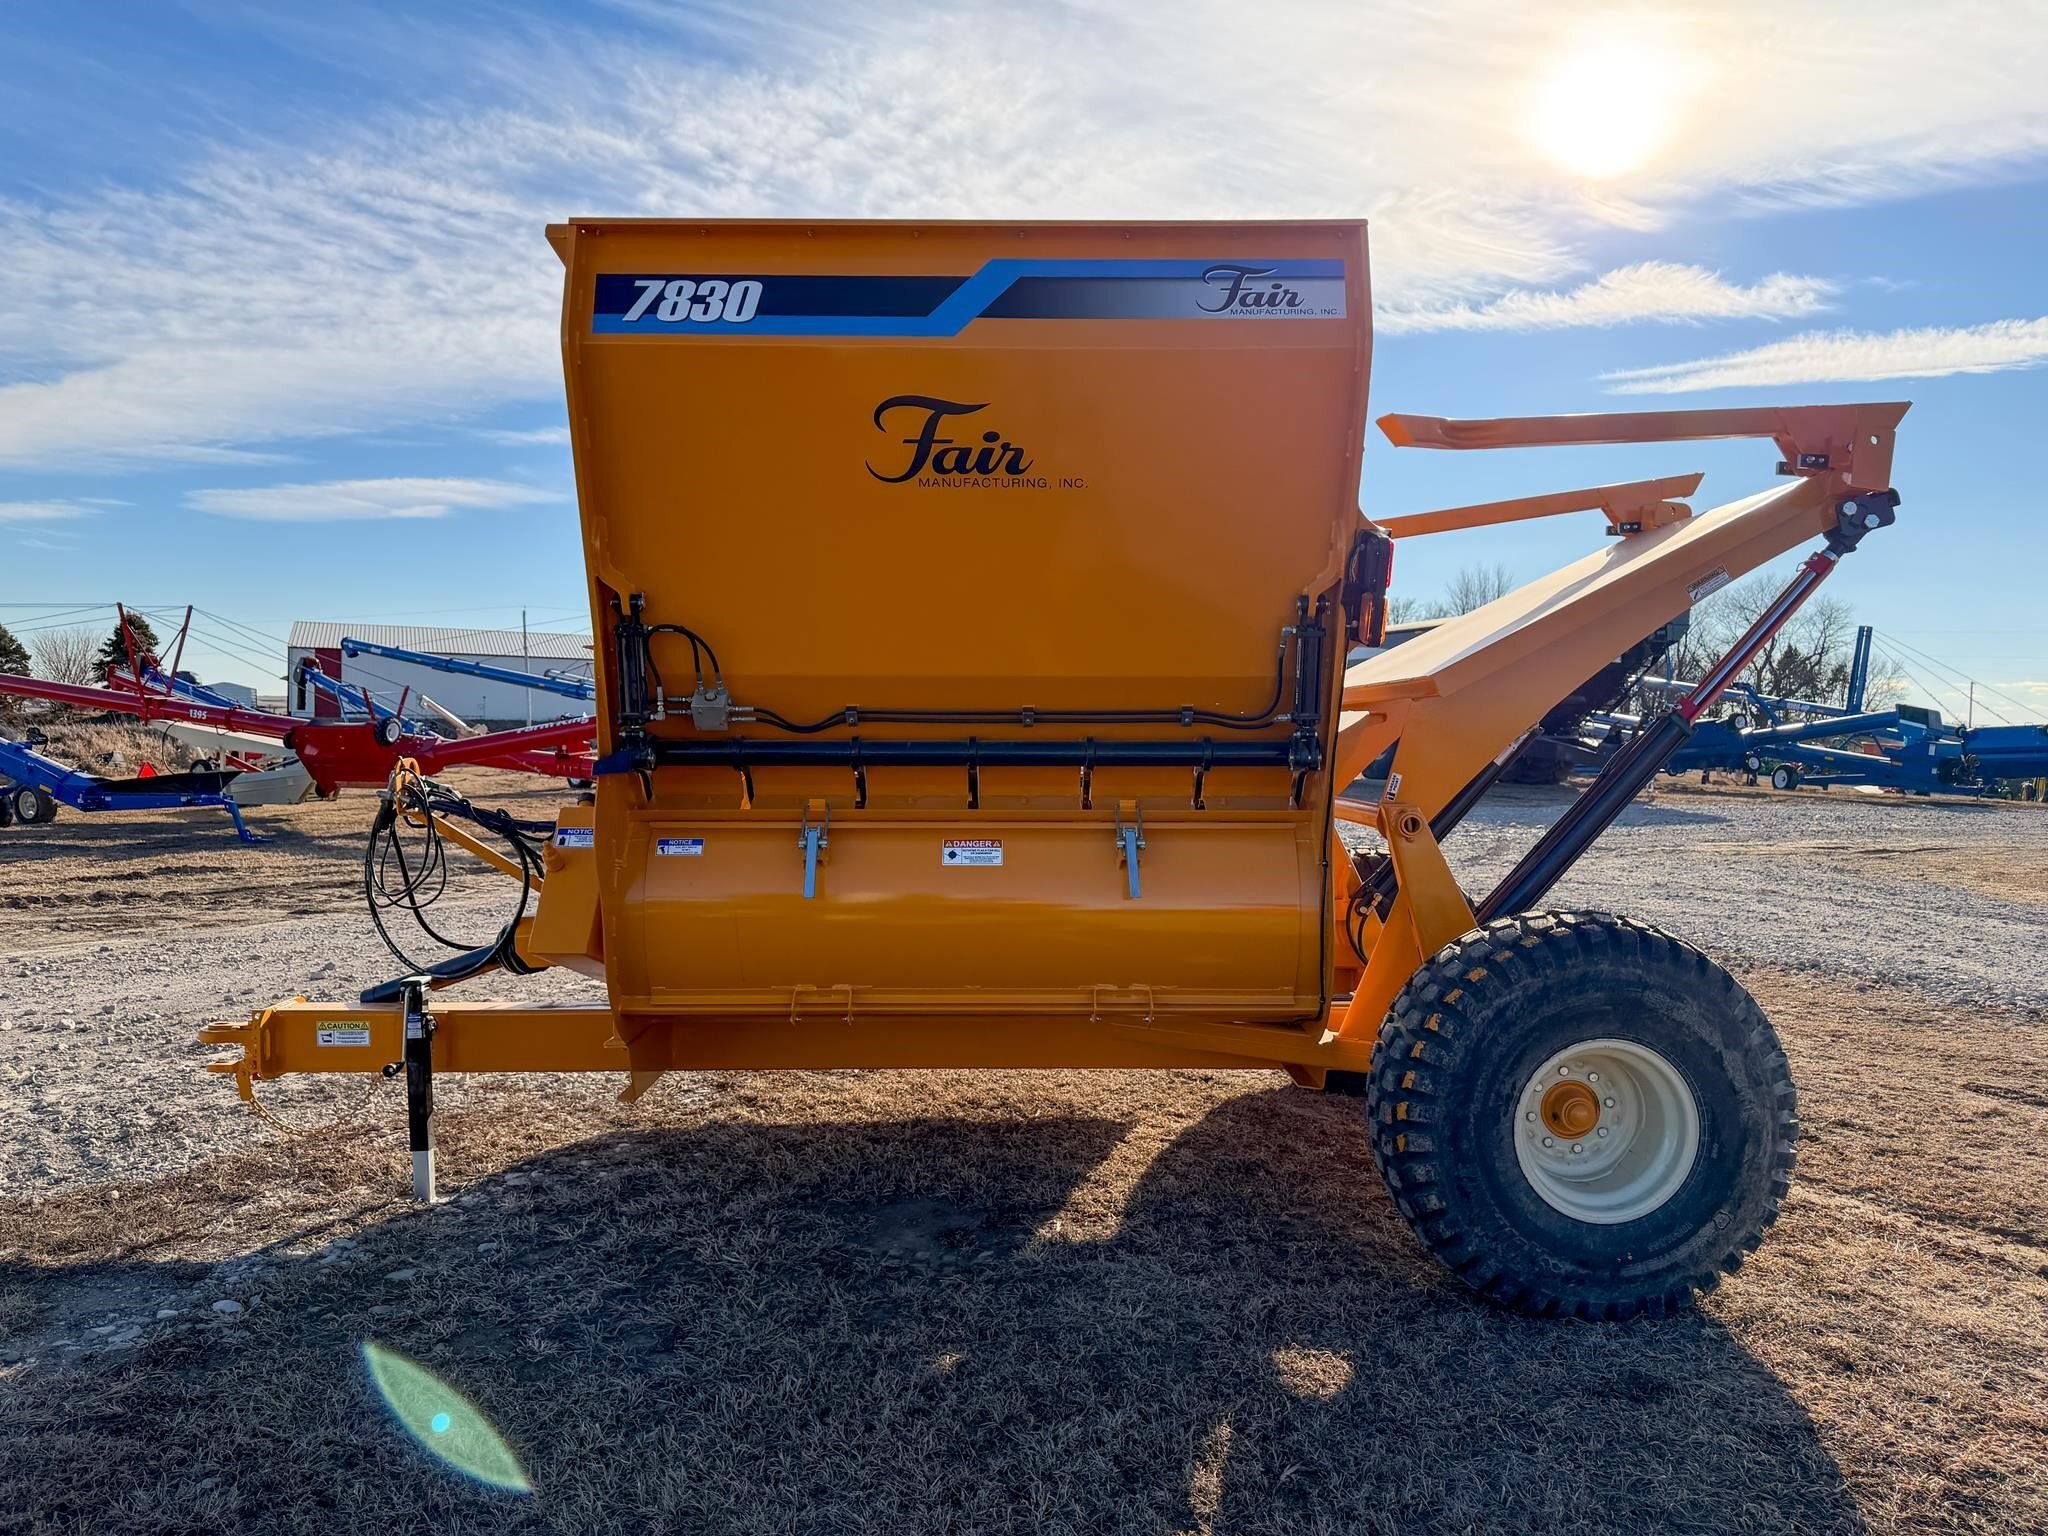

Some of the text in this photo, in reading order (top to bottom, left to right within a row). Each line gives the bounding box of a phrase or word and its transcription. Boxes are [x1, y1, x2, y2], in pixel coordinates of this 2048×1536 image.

[1195, 264, 1306, 313] Fair
[622, 280, 763, 322] 7830
[1230, 308, 1341, 316] MANUFACTURING, INC.
[865, 395, 1034, 483] Fair
[918, 477, 1088, 489] MANUFACTURING, INC.
[189, 709, 208, 719] 1395
[953, 840, 992, 848] DANGER
